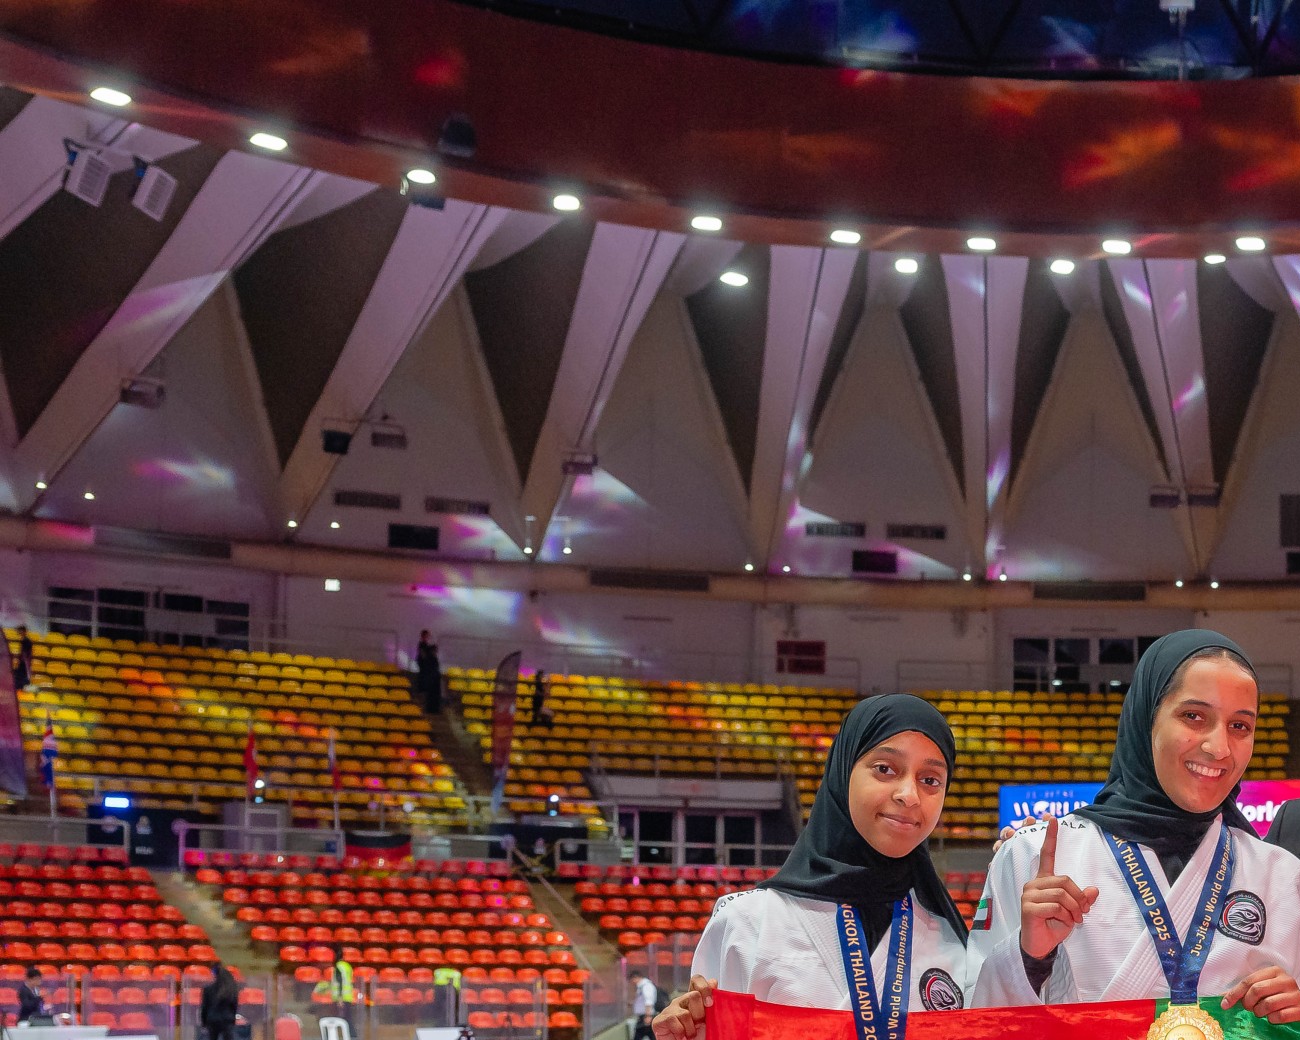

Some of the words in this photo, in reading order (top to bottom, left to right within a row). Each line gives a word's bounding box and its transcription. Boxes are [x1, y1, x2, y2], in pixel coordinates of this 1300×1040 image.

[1236, 800, 1286, 822] orl
[1120, 846, 1157, 906] THAILAND
[1148, 908, 1171, 941] 2025
[1191, 914, 1212, 957] Ju-Jitsu
[1205, 882, 1222, 913] World
[850, 950, 874, 1021] THAILAND
[892, 915, 910, 993] Championships
[887, 995, 901, 1029] World
